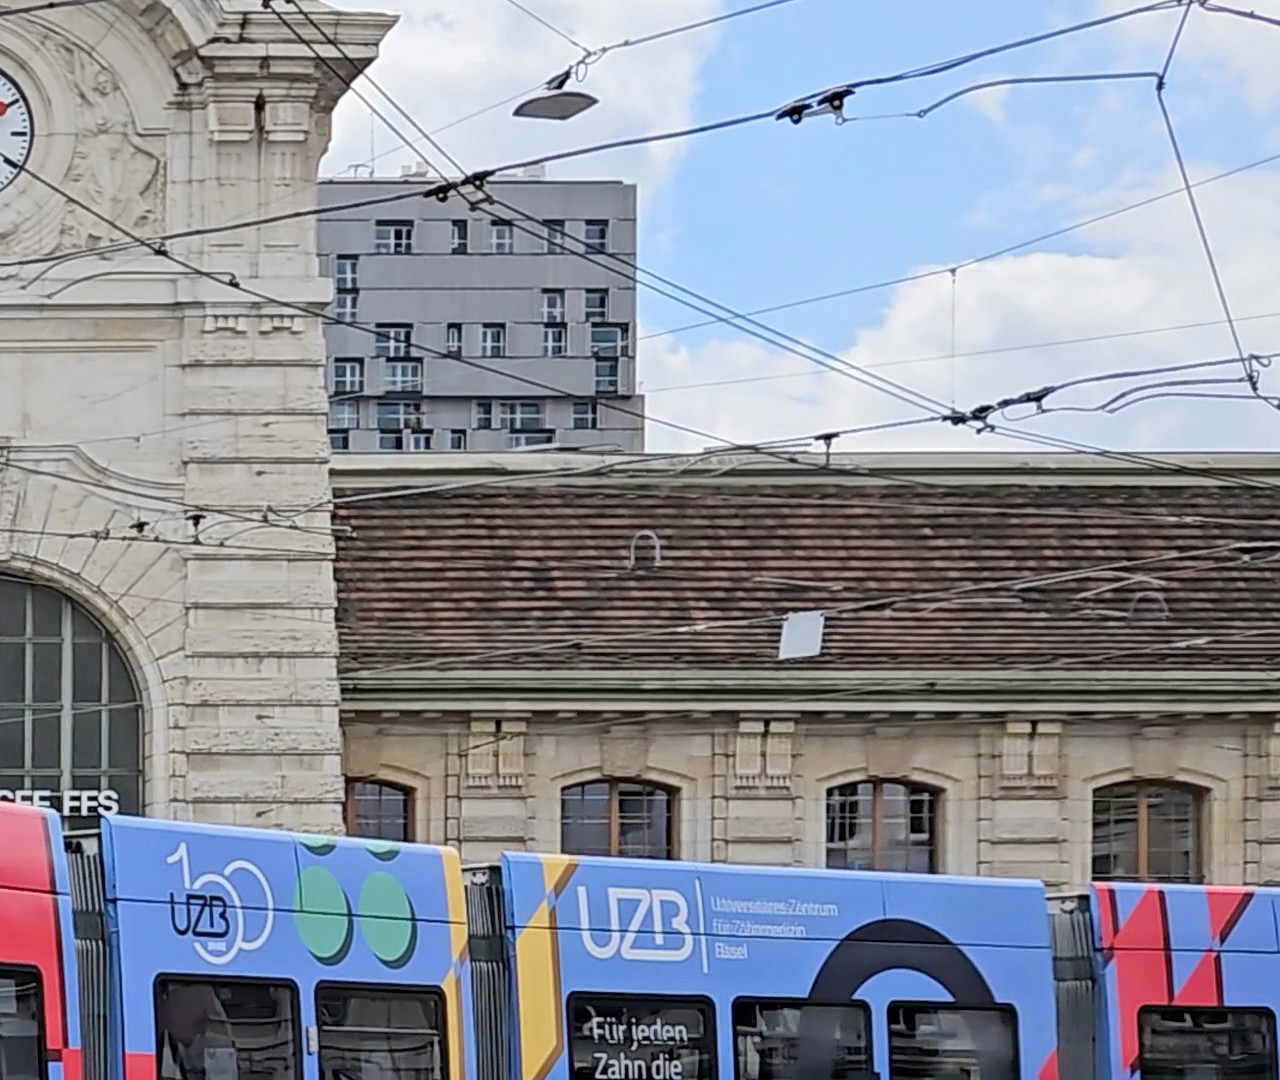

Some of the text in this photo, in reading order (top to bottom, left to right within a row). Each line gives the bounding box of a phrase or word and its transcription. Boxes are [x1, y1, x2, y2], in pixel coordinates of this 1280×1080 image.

[63, 790, 119, 816] FFS
[169, 891, 230, 938] UZB
[577, 885, 693, 961] UZB
[592, 1017, 688, 1050] Für jeden
[594, 1053, 682, 1080] Zahn die
